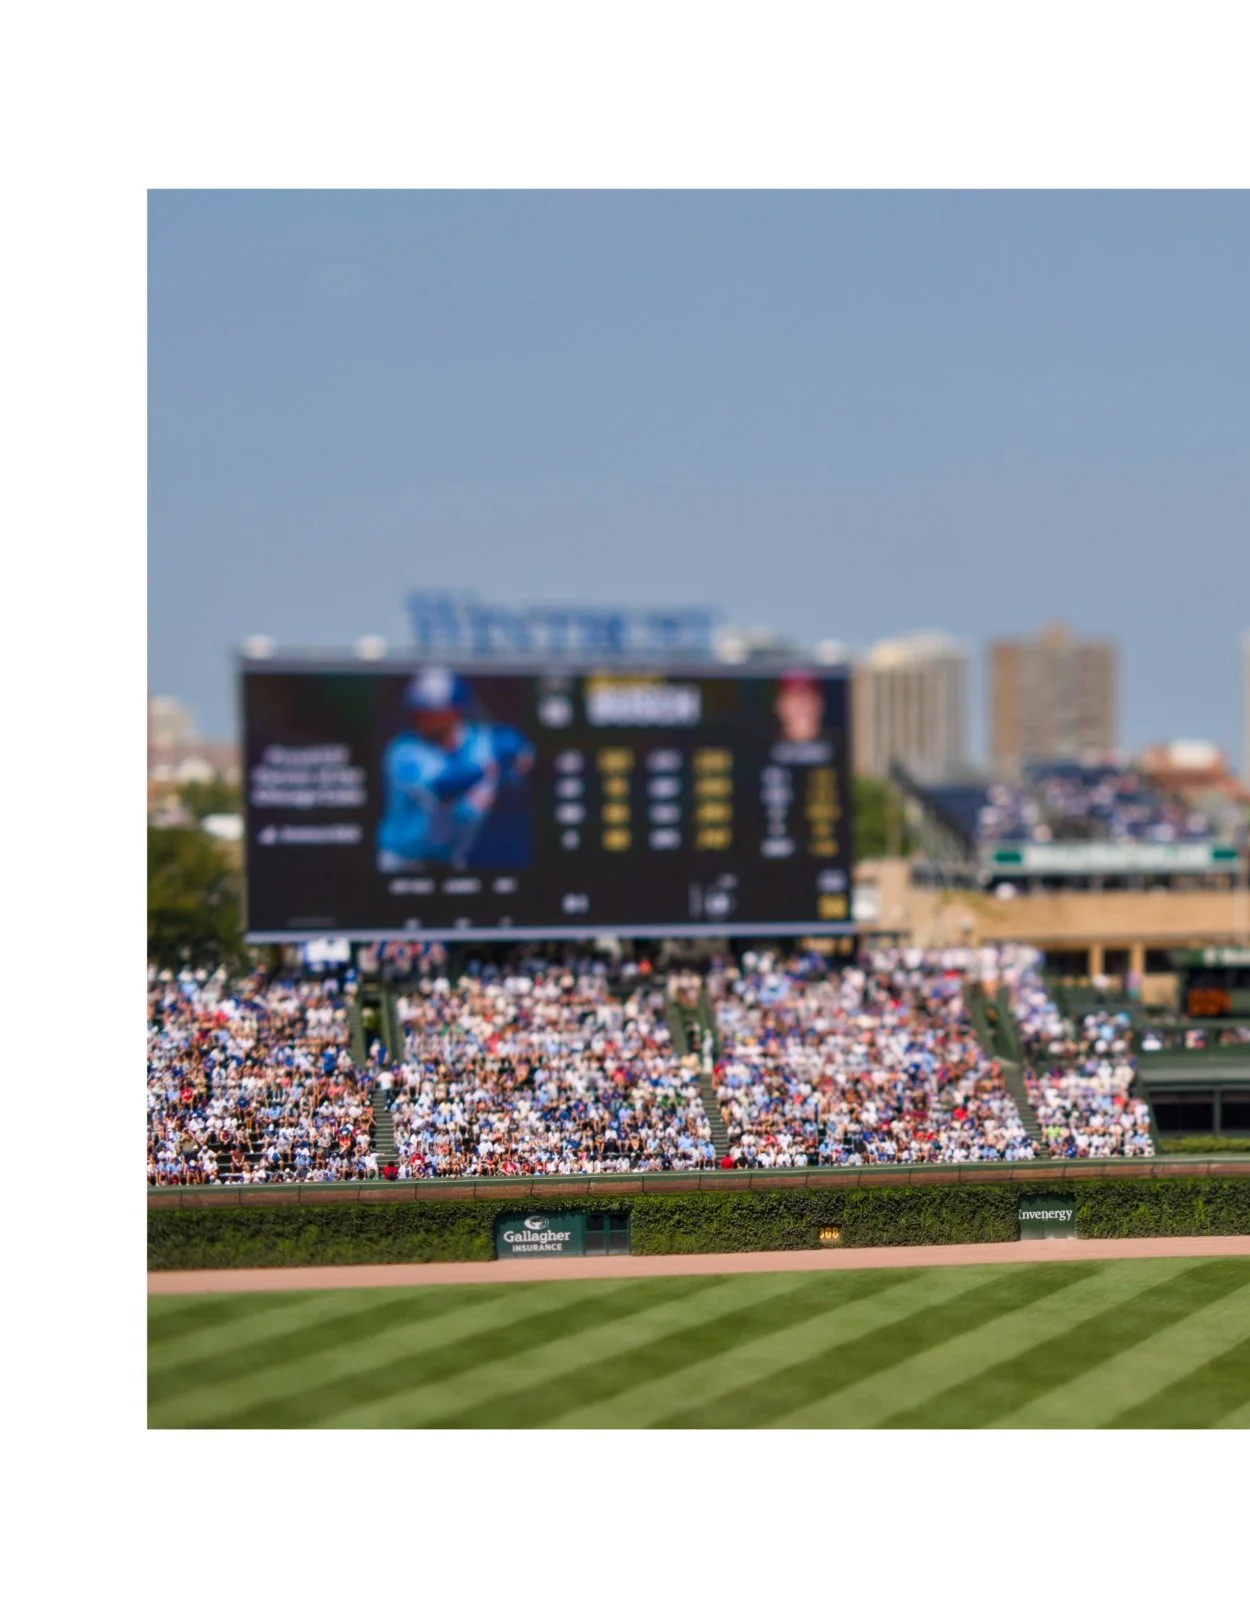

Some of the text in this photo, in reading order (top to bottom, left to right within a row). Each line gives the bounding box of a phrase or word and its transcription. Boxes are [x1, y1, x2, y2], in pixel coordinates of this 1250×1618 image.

[1018, 1210, 1073, 1220] Invenergy
[503, 1230, 571, 1243] Gallagher
[512, 1243, 563, 1252] INSURANCE
